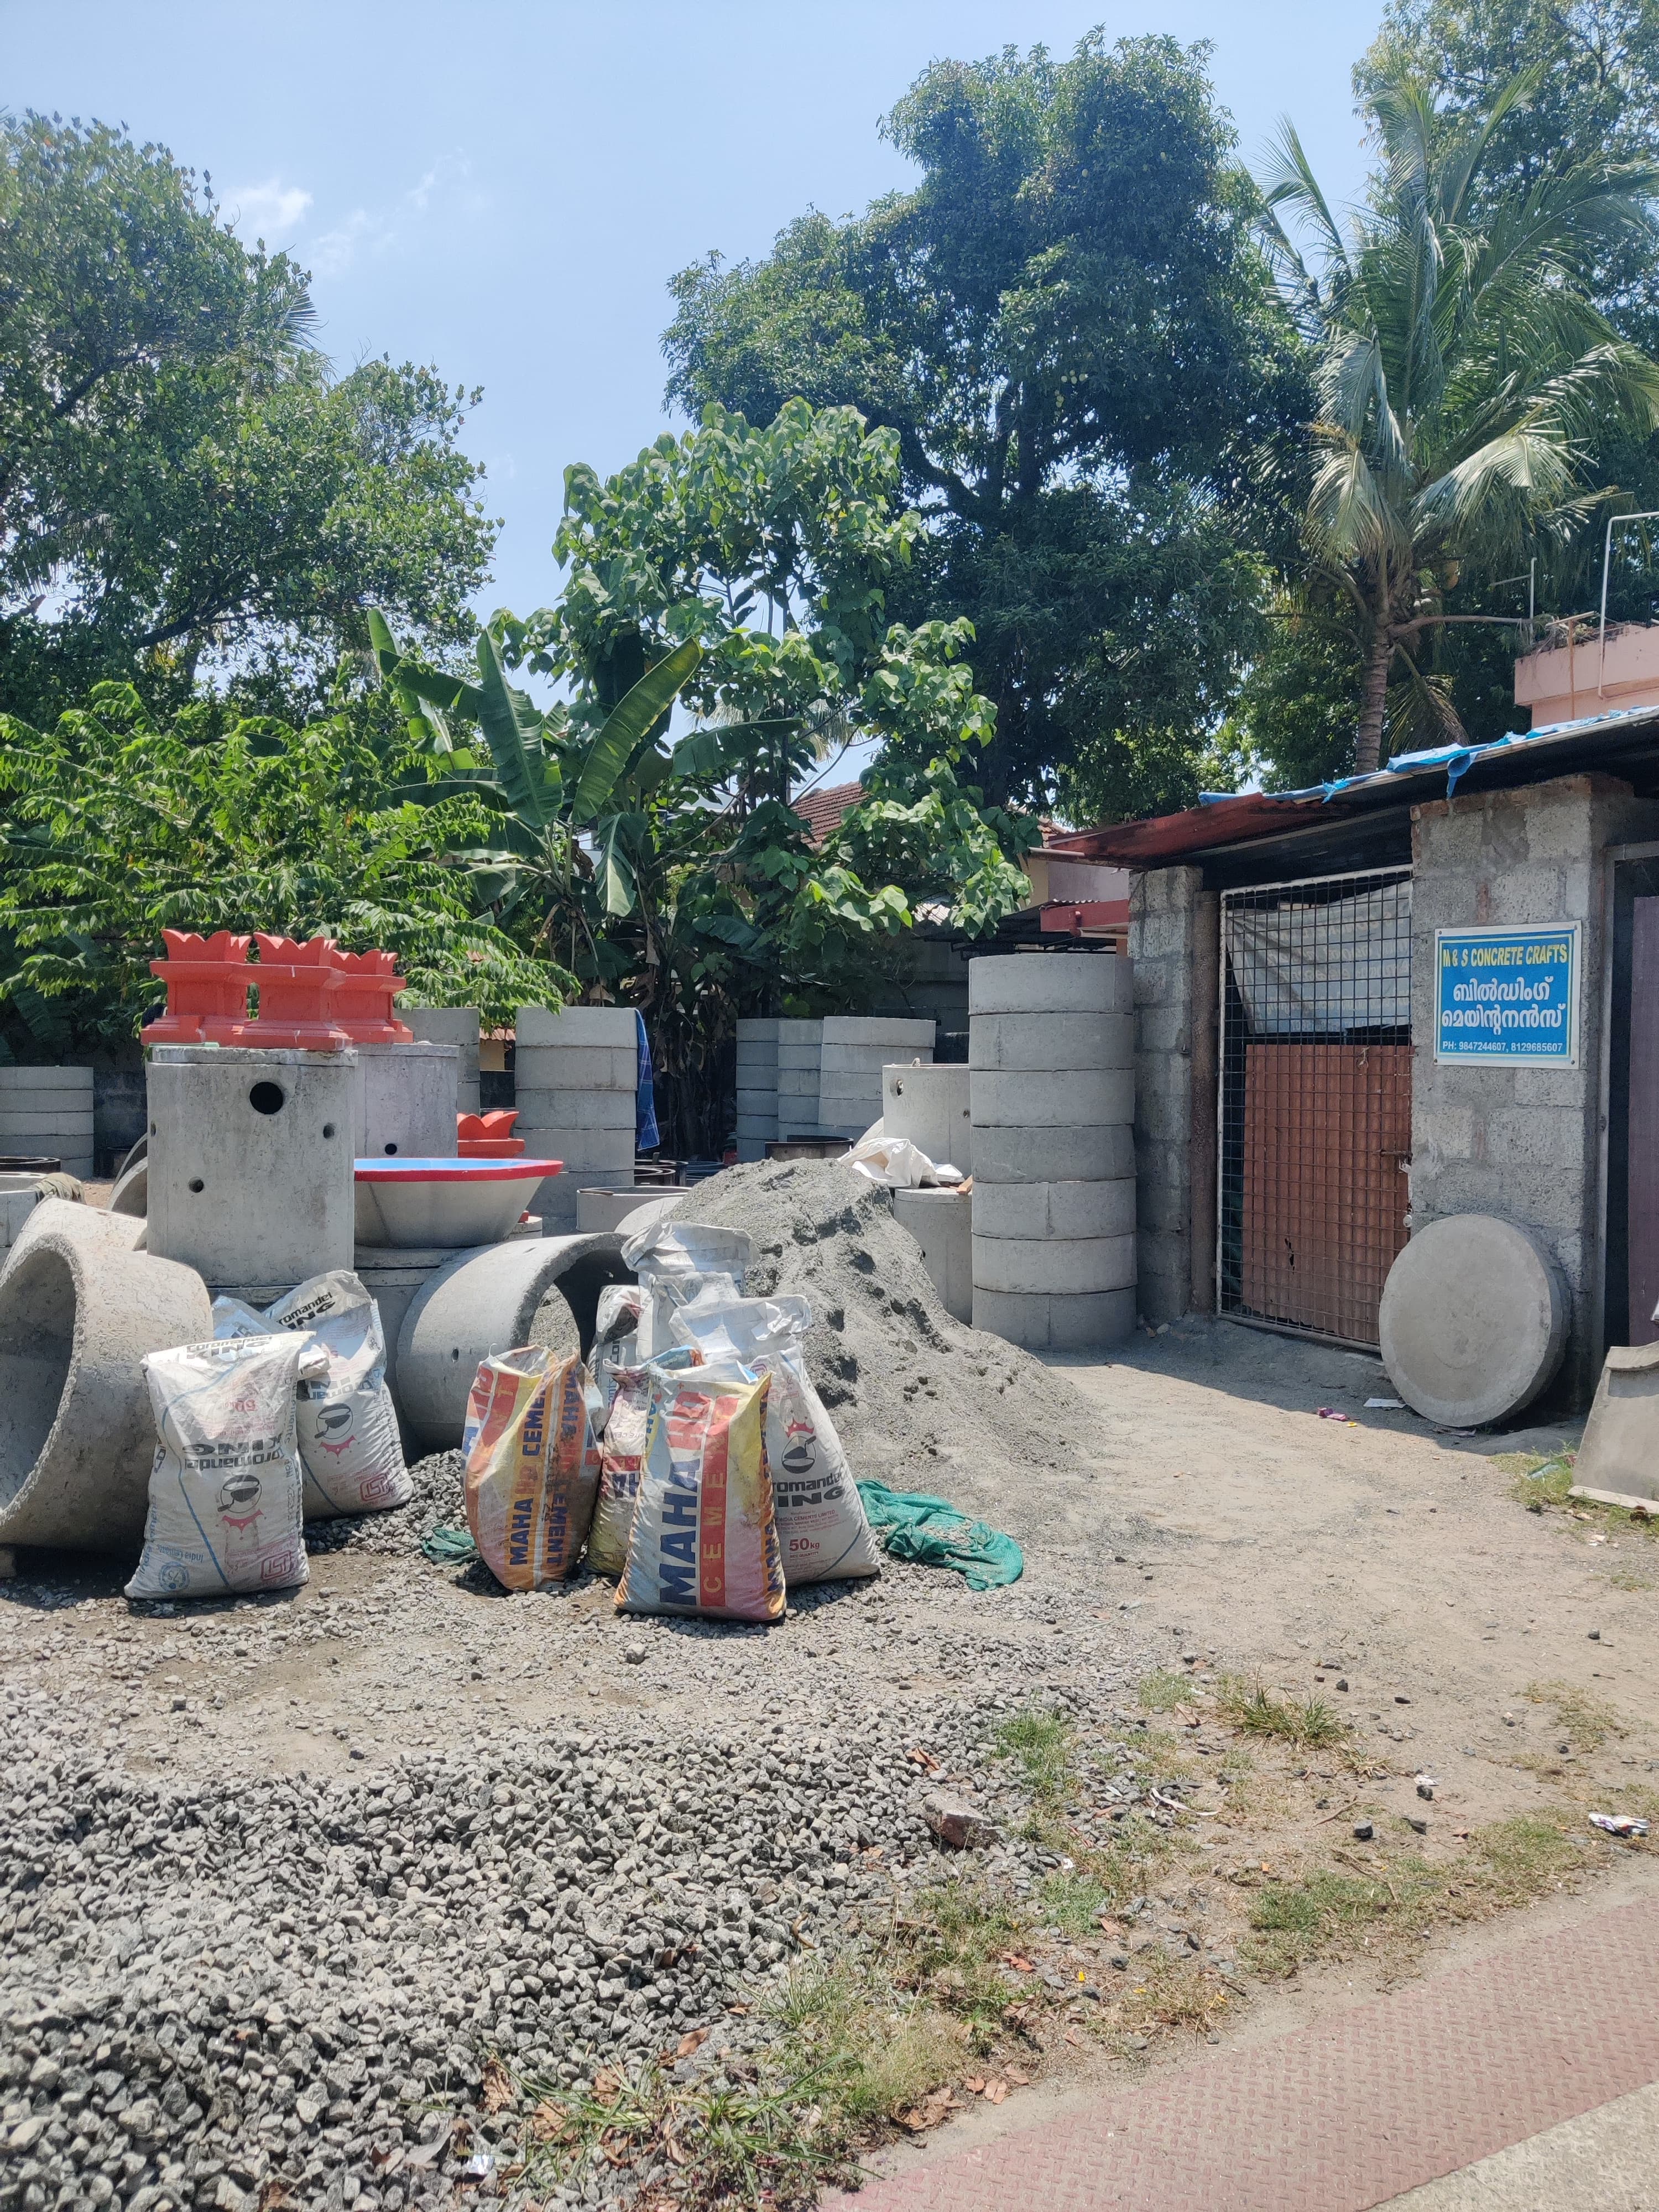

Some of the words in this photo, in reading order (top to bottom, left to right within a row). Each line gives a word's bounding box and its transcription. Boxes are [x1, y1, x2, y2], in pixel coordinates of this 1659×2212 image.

[1443, 949, 1451, 967] M
[1452, 949, 1458, 967] &
[1461, 949, 1468, 967] S
[1470, 946, 1524, 967] CONCRETE
[1525, 943, 1568, 964] CRAFTS
[1442, 1041, 1457, 1050] PH:
[1459, 1042, 1509, 1053] 9847244607,
[1511, 1043, 1563, 1052] 8129685607
[778, 1486, 846, 1507] ING
[818, 1509, 836, 1518] LIMITED
[509, 1498, 534, 1566] MAHA
[660, 1459, 701, 1606] MAHA
